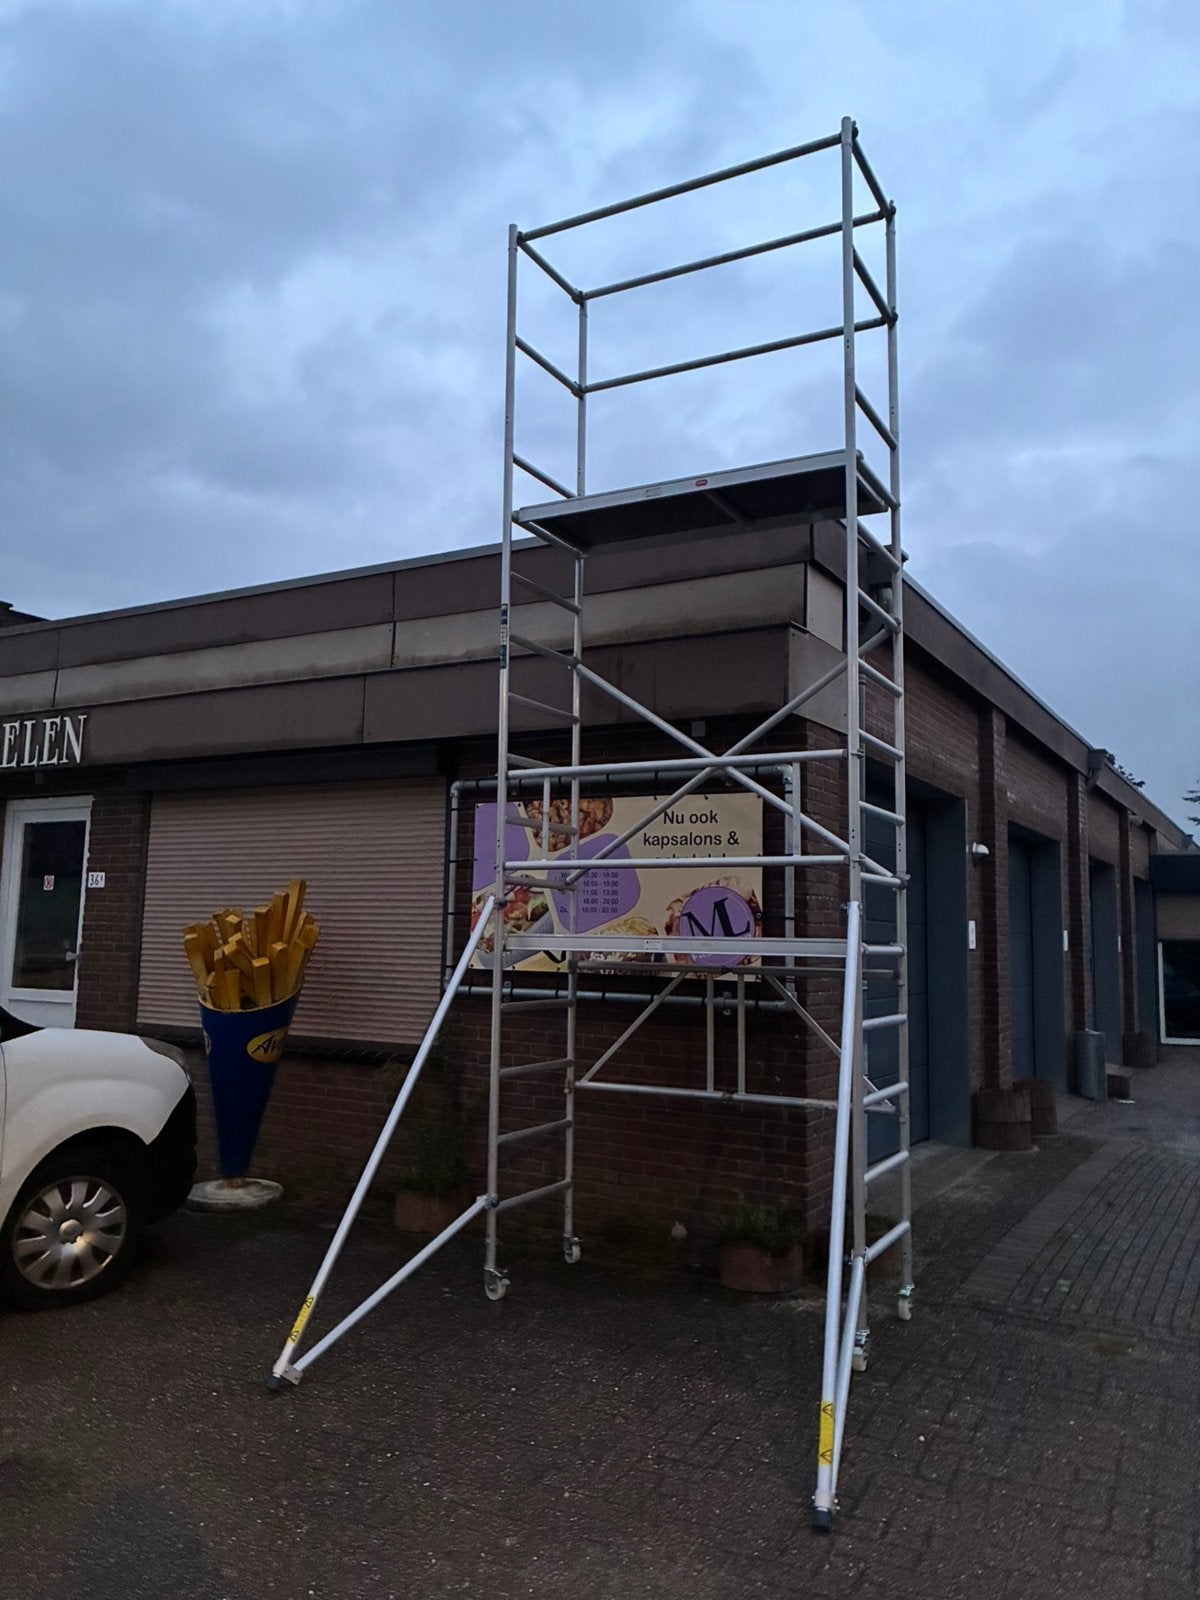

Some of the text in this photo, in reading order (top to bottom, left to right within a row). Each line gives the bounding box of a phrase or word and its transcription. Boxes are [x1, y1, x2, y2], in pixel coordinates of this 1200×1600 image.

[0, 715, 88, 768] ELEN
[664, 810, 718, 825] Nu ook
[643, 831, 739, 849] kapsalons &
